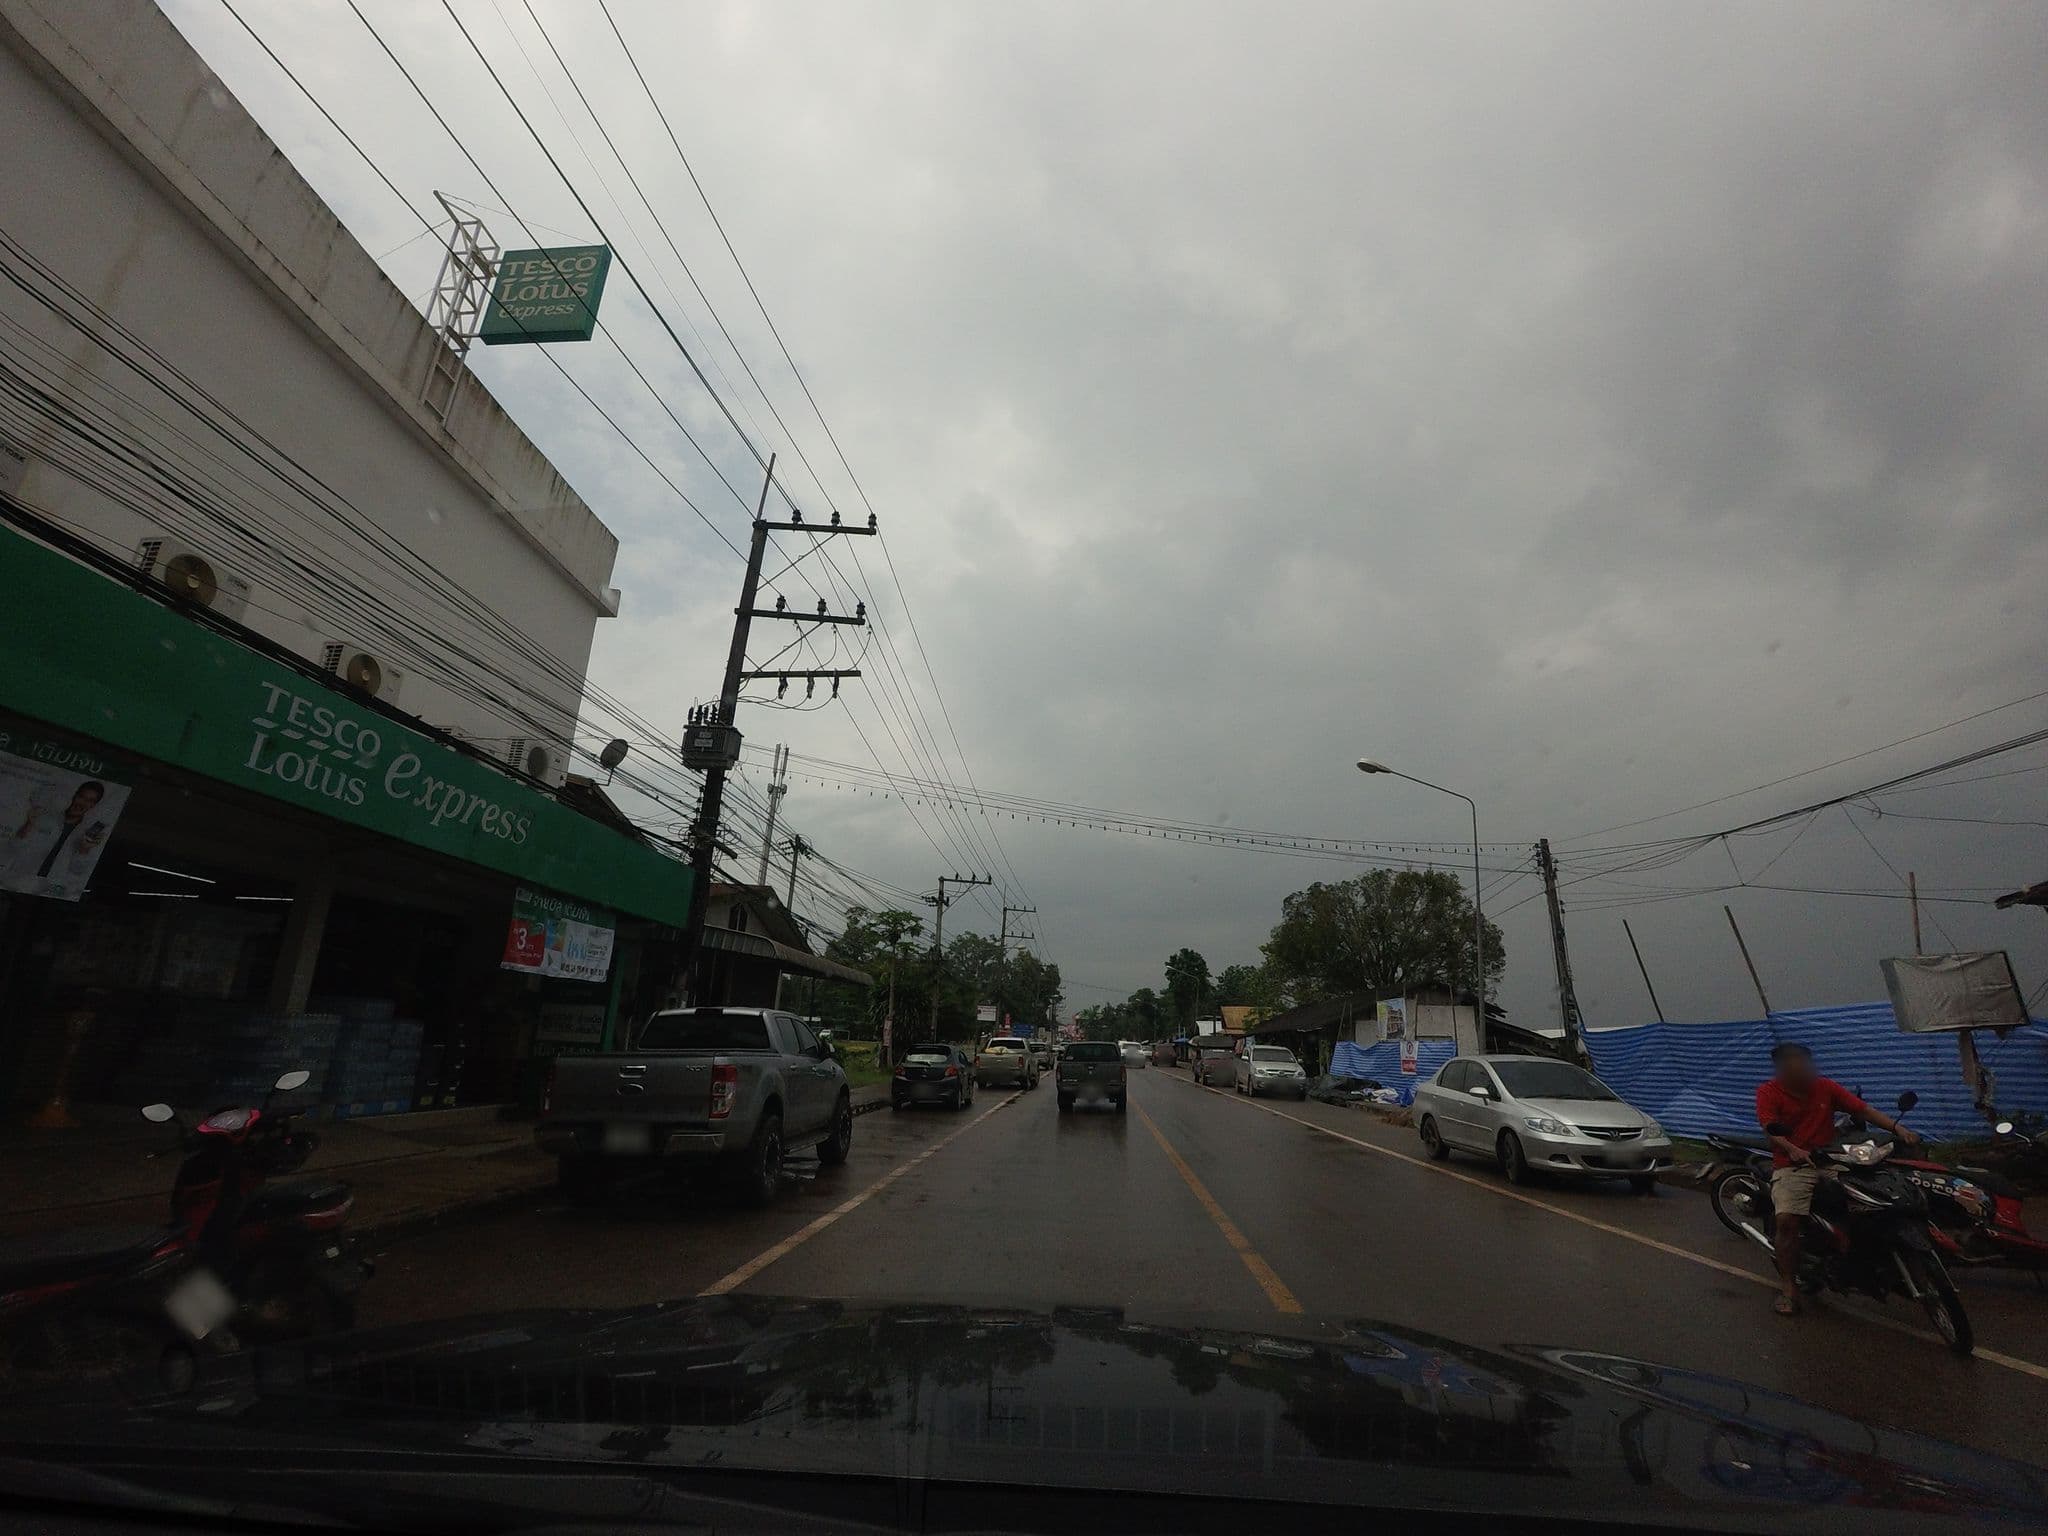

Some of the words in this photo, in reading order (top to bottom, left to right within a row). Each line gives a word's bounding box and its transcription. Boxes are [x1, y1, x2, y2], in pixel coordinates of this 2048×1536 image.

[506, 256, 597, 276] TESCO
[500, 280, 588, 303] Lotus
[498, 302, 576, 320] express
[243, 731, 367, 806] Lotus
[261, 681, 381, 758] TESCO
[384, 752, 532, 845] express
[516, 927, 528, 950] 3
